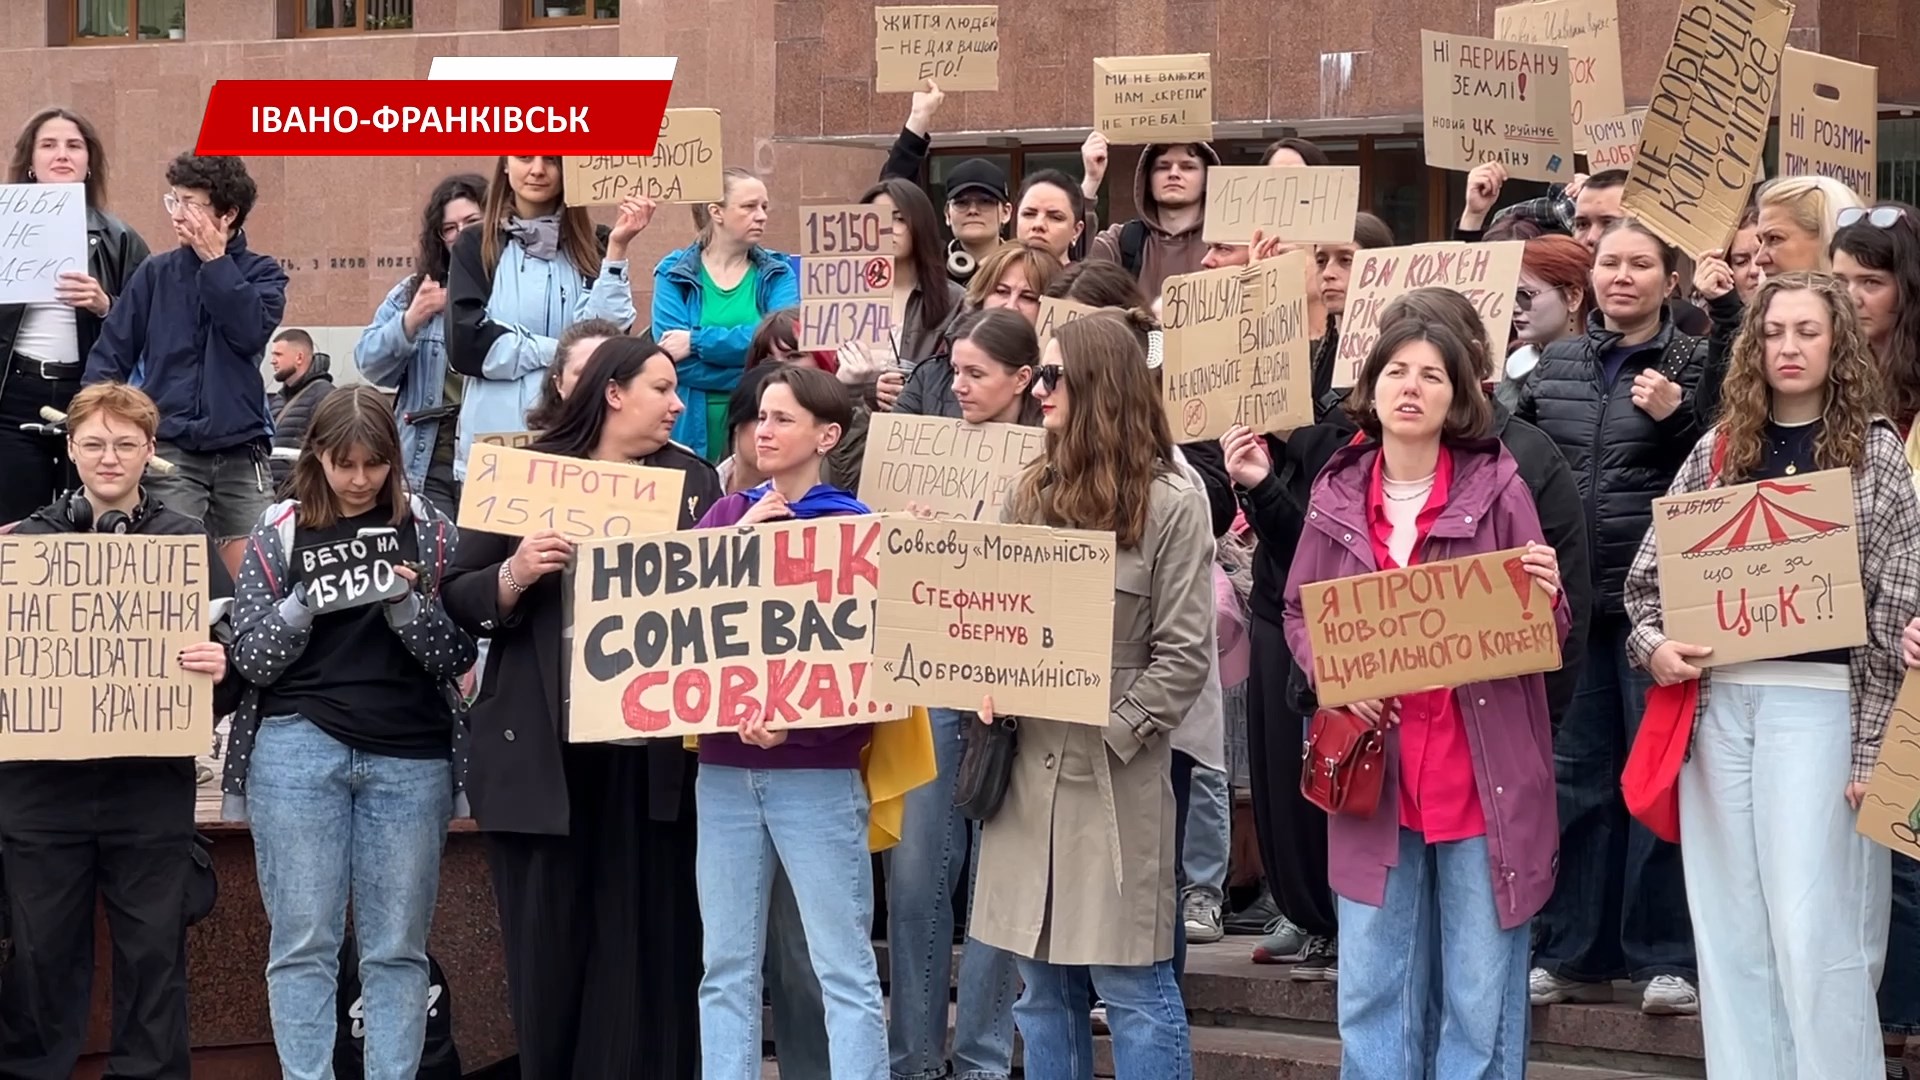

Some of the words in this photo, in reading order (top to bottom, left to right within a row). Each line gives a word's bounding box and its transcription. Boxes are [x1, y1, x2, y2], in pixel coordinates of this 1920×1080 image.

[882, 14, 941, 32] ЖИТТЯ
[900, 39, 922, 55] НЕ
[925, 39, 953, 57] ДЛЯ
[1459, 44, 1559, 76] ДЕРИБАНУ
[1651, 4, 1712, 125] РОБІТЬ
[919, 56, 963, 80] ЕГО!
[1105, 74, 1127, 86] МИ
[1133, 74, 1152, 83] НЕ
[1115, 92, 1143, 104] НАМ
[1716, 37, 1780, 190] cringe
[1102, 118, 1122, 130] НЕ
[1472, 117, 1496, 136] ЦК
[1584, 120, 1626, 145] ЧОМУ
[1814, 118, 1871, 155] РОЗМИ-
[1632, 139, 1673, 194] НЕ
[1785, 152, 1809, 176] ТИМ
[592, 174, 682, 201] ПРАВА
[2, 221, 45, 249] НЕ
[808, 259, 870, 296] КРОК
[1403, 248, 1491, 288] КОЖЕН
[803, 302, 894, 347] НАЗАД
[887, 421, 994, 463] ВНЕСІТЬ
[476, 454, 497, 483] Я
[527, 459, 656, 502] ПРОТИ
[878, 461, 990, 500] ПОПРАВКИ
[476, 496, 631, 538] 15150
[28, 538, 200, 587] ЗАБИРАЙТЕ
[302, 540, 367, 573] ВЕТО
[376, 536, 399, 553] НА
[591, 526, 761, 602] НОВИЙ
[307, 559, 395, 608] 15150
[1317, 585, 1340, 624] Я
[1352, 558, 1493, 614] ПРОТИ
[7, 593, 61, 632] НАС
[71, 590, 200, 634] БАЖАННЯ
[761, 598, 877, 656] BAC
[1323, 608, 1446, 646] НОВОГО
[4, 636, 168, 679] РОЗВИВАТИ
[1315, 633, 1473, 690] ЦИВІЛЬНОГО
[92, 682, 192, 733] КРАЇНУ
